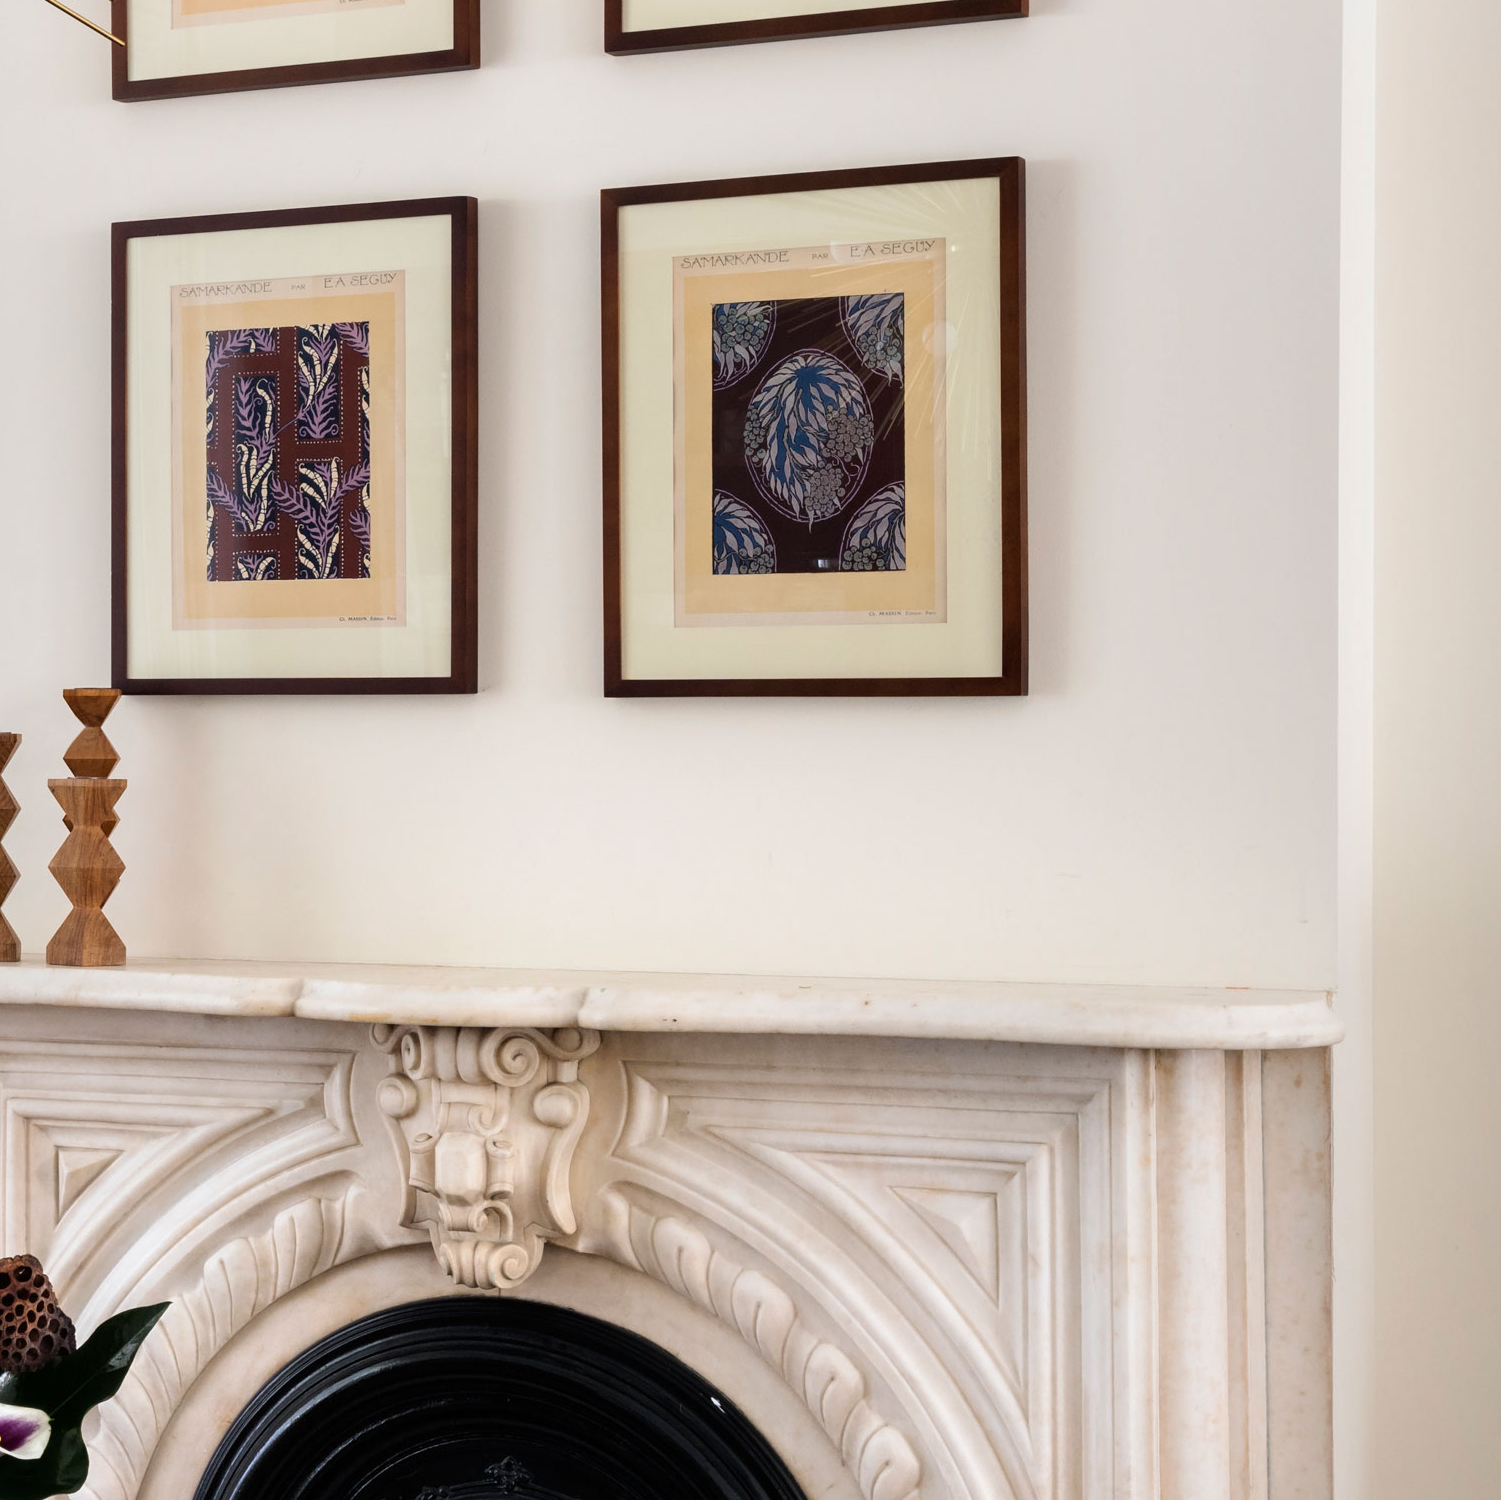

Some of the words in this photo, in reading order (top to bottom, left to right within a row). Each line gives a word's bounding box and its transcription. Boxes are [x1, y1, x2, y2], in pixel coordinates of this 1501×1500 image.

[681, 250, 790, 269] SAMARKANDE
[880, 240, 936, 255] SEGUY
[179, 282, 273, 298] SAMARKANDE
[350, 272, 397, 286] SEGUY
